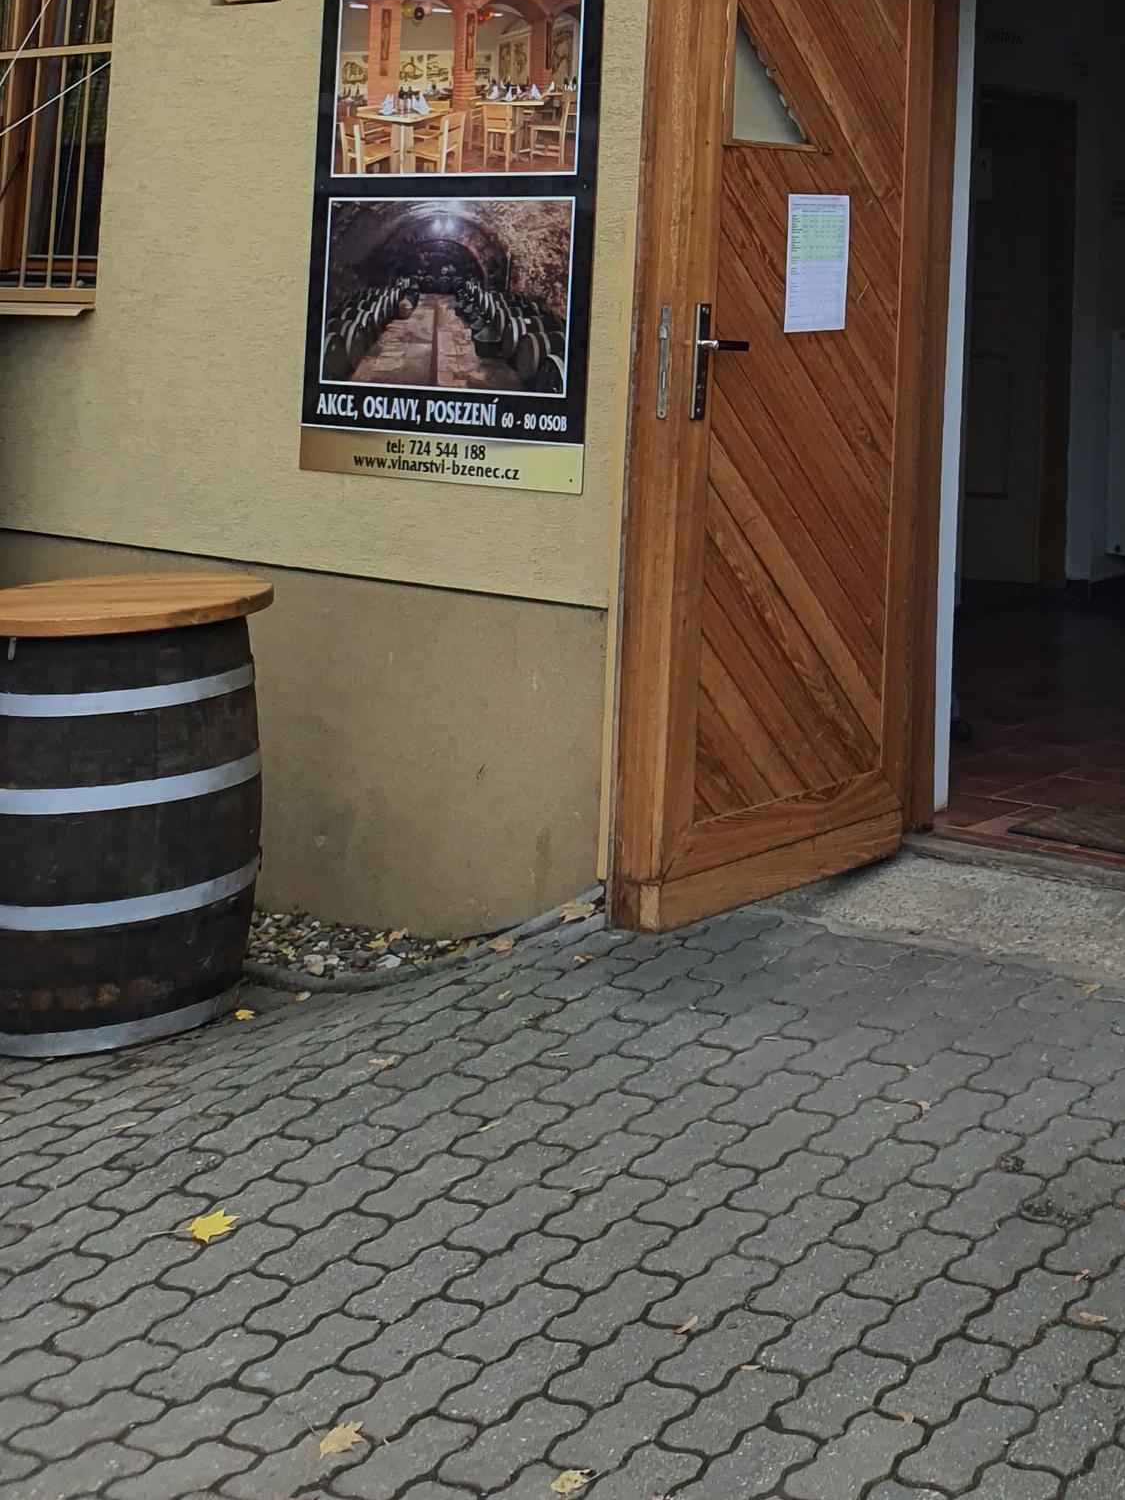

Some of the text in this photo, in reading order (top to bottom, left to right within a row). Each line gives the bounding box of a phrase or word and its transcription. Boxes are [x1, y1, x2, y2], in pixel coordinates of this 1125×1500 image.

[317, 393, 358, 420] AKCE,
[363, 396, 420, 424] OSLAVY,
[426, 398, 498, 428] POSEZENÍ
[501, 411, 514, 428] 60
[524, 413, 536, 430] 80
[538, 414, 567, 433] OSOB
[386, 438, 486, 461] tel: 724 544 188
[353, 455, 519, 481] www.vinarstvi-bzenec.cz
